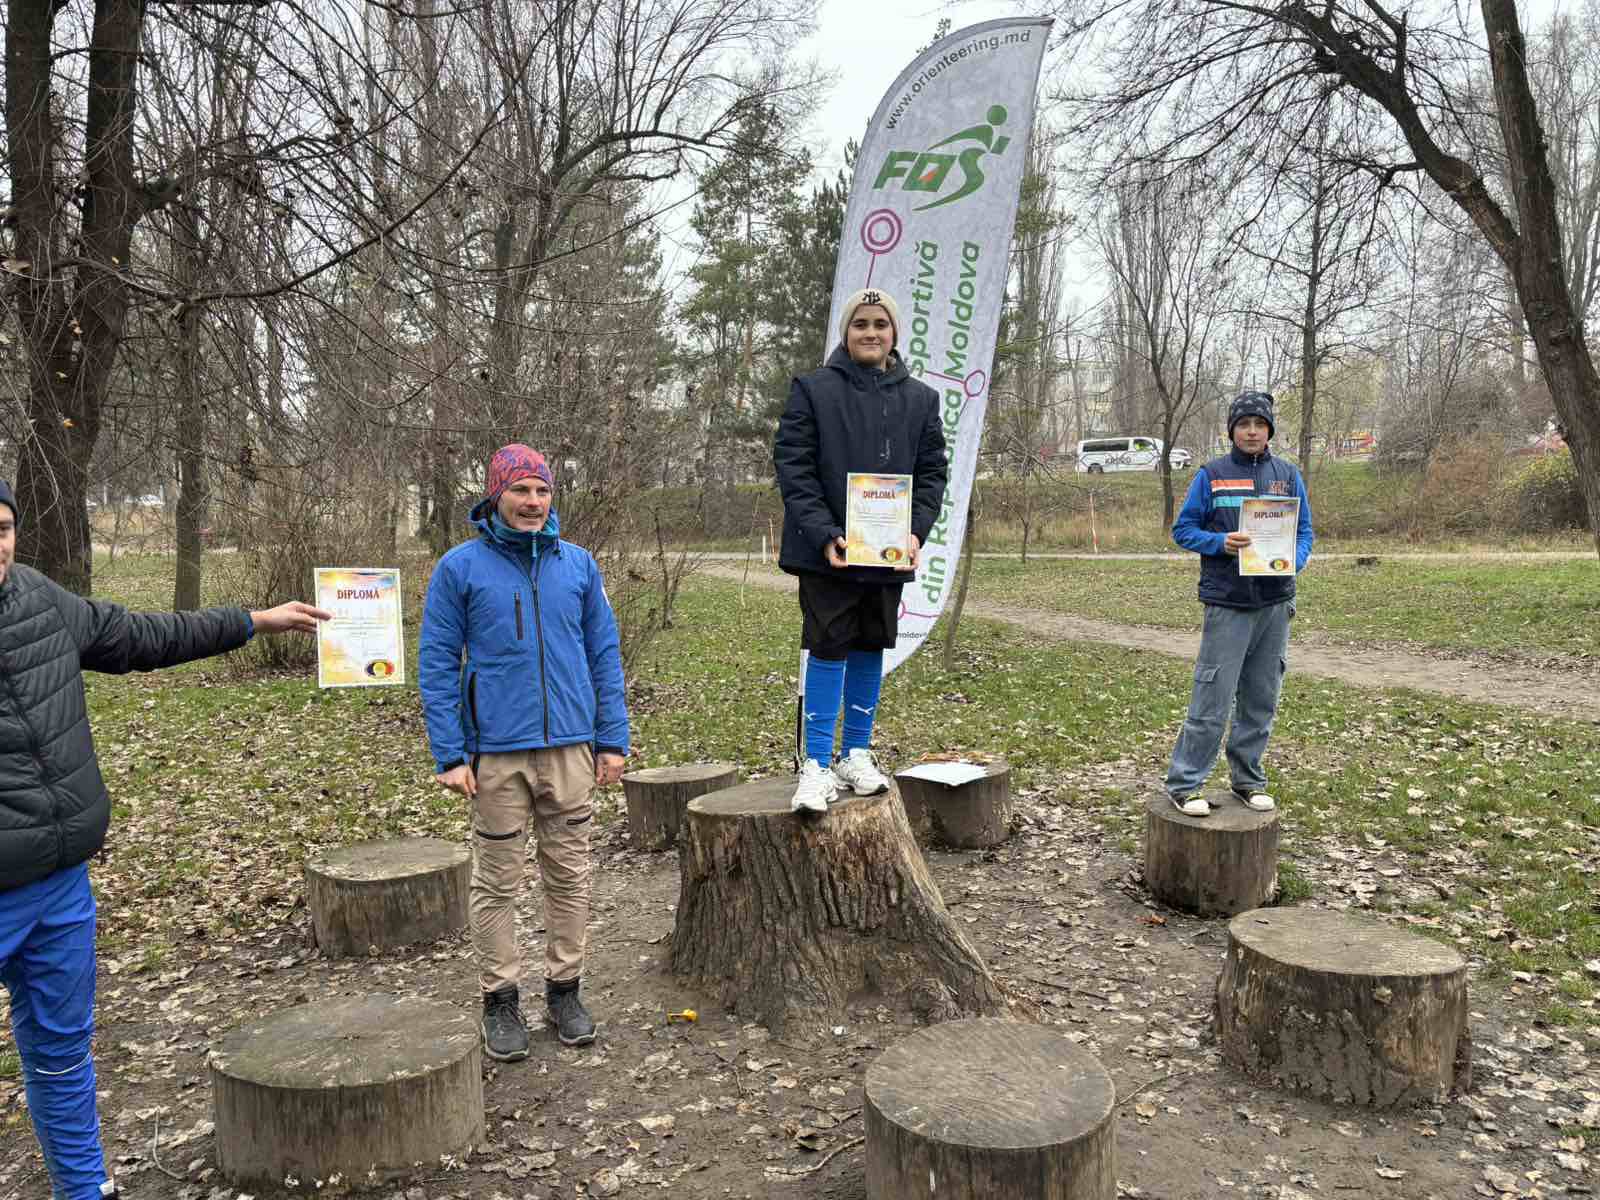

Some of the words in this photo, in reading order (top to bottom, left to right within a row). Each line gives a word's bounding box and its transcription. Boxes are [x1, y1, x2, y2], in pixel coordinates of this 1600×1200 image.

[886, 29, 1032, 130] www.orienteering.md
[921, 557, 946, 604] din
[943, 240, 981, 379] Moldova
